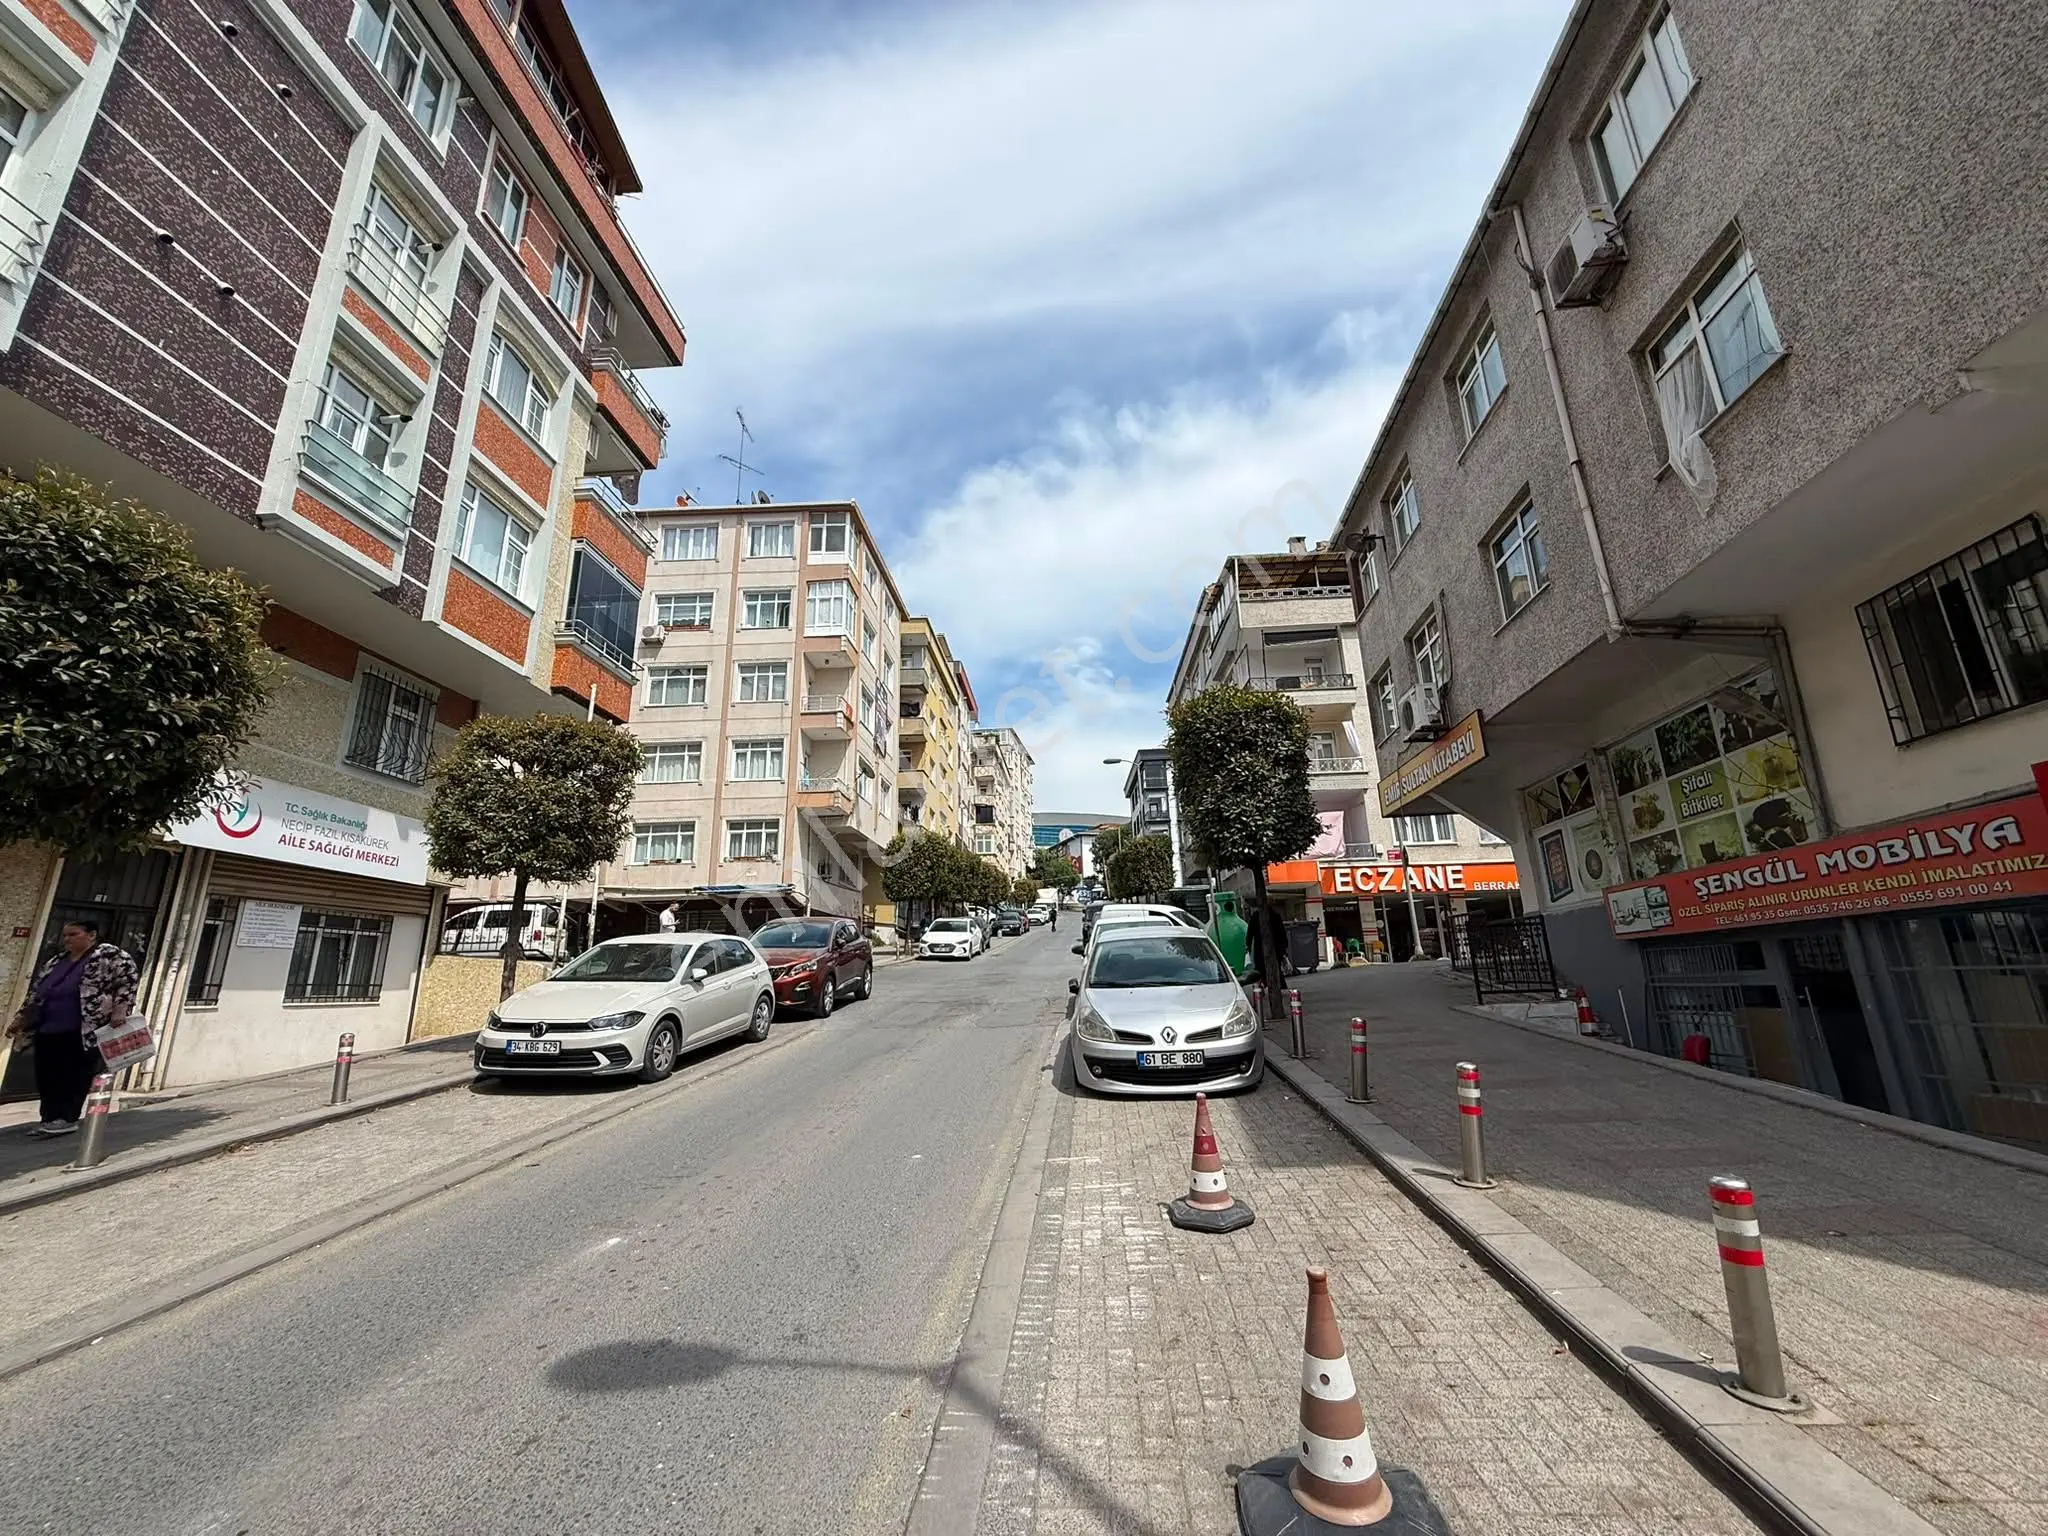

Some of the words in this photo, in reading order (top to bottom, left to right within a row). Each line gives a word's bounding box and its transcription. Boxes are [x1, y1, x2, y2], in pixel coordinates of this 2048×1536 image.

[1401, 761, 1431, 796] SULTAN
[1432, 724, 1476, 778] KİTABEVİ
[301, 806, 328, 821] Sağlık
[330, 813, 368, 831] Bakanlığı
[1681, 794, 1723, 817] Bitkiler
[281, 816, 312, 833] NECİP
[314, 825, 339, 840] FAZIL
[278, 832, 307, 849] AİLE
[308, 839, 353, 858] SAĞLIĞI
[355, 849, 400, 867] MERKEZİ
[1693, 856, 1808, 902] ŞENGÜL
[1815, 815, 2024, 876] MOBİLYA
[1335, 865, 1466, 892] ECZANE
[1748, 892, 1790, 908] ALINIR
[1864, 869, 1917, 893] KENDİ
[1777, 907, 1801, 919] Gsm:
[1804, 904, 1829, 915] 0535
[1833, 900, 1853, 911] 746
[1857, 899, 1871, 909] 26
[1874, 896, 1889, 906] 68
[1900, 889, 1933, 904] 0555
[1937, 886, 1964, 899] 691
[1969, 882, 1989, 896] 00
[1993, 879, 2013, 892] 41
[512, 1041, 521, 1051] 34
[525, 1042, 540, 1052] KBG
[543, 1042, 558, 1052] 629
[1145, 1054, 1156, 1065] 61
[1161, 1053, 1178, 1064] BE
[1182, 1052, 1202, 1064] 880
